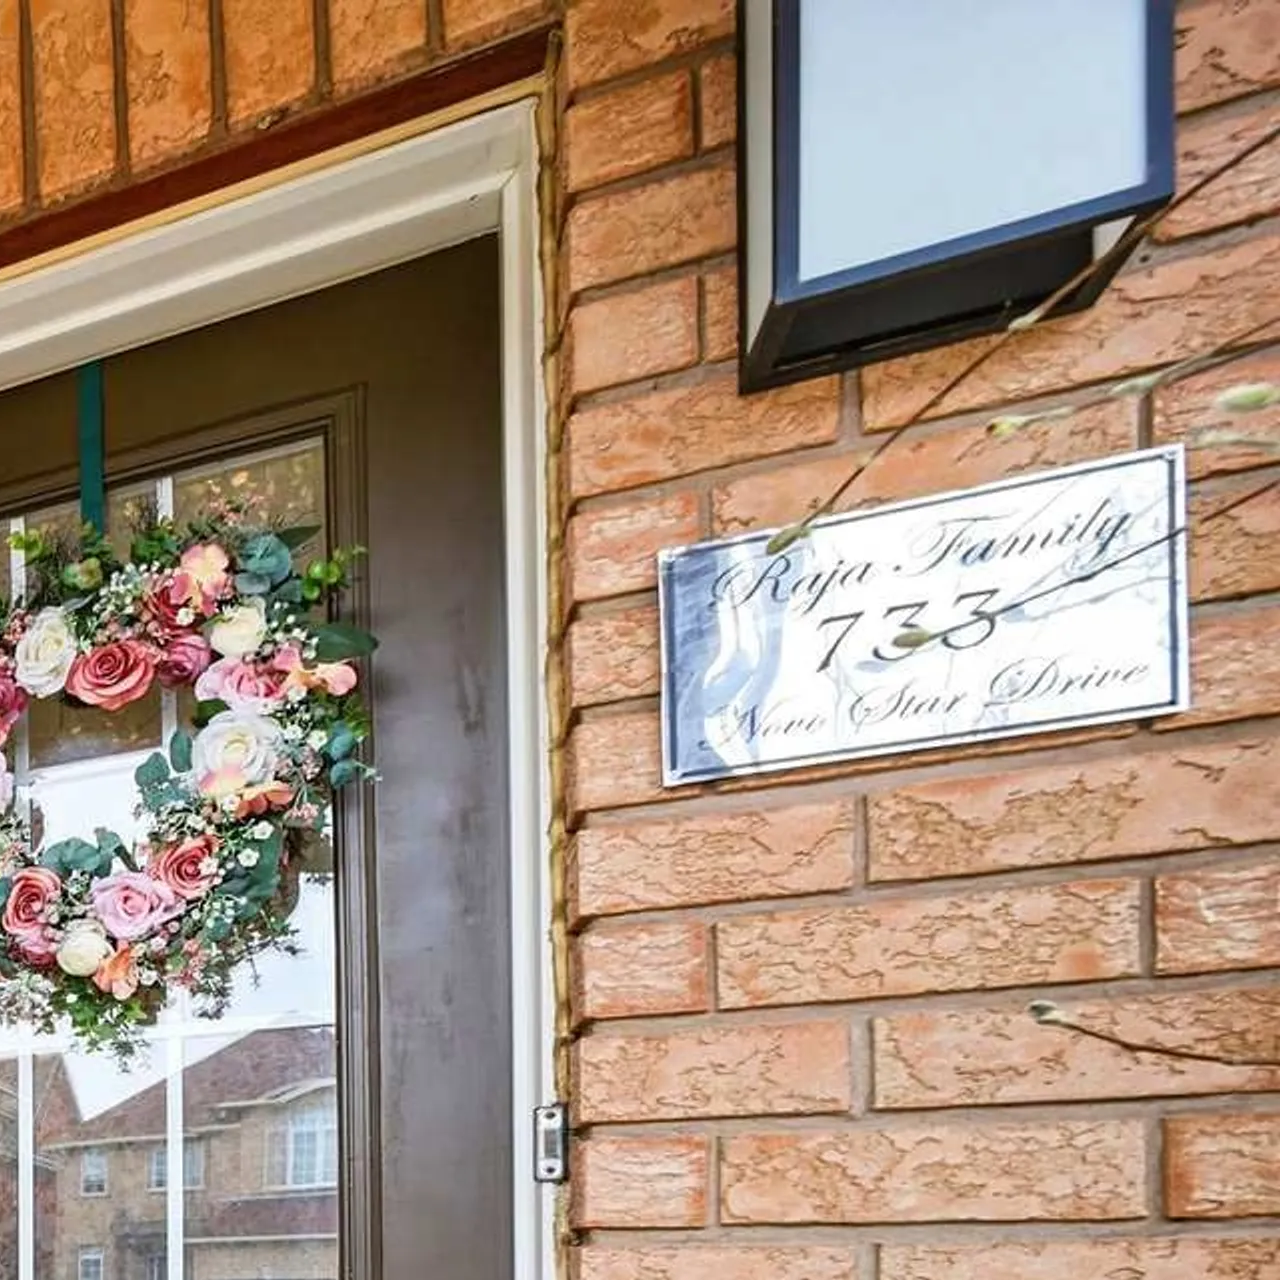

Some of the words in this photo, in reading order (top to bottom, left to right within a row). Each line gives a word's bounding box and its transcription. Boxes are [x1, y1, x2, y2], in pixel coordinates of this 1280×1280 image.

[711, 553, 871, 616] Raja
[896, 498, 1136, 572] Family
[816, 588, 1000, 673] 733
